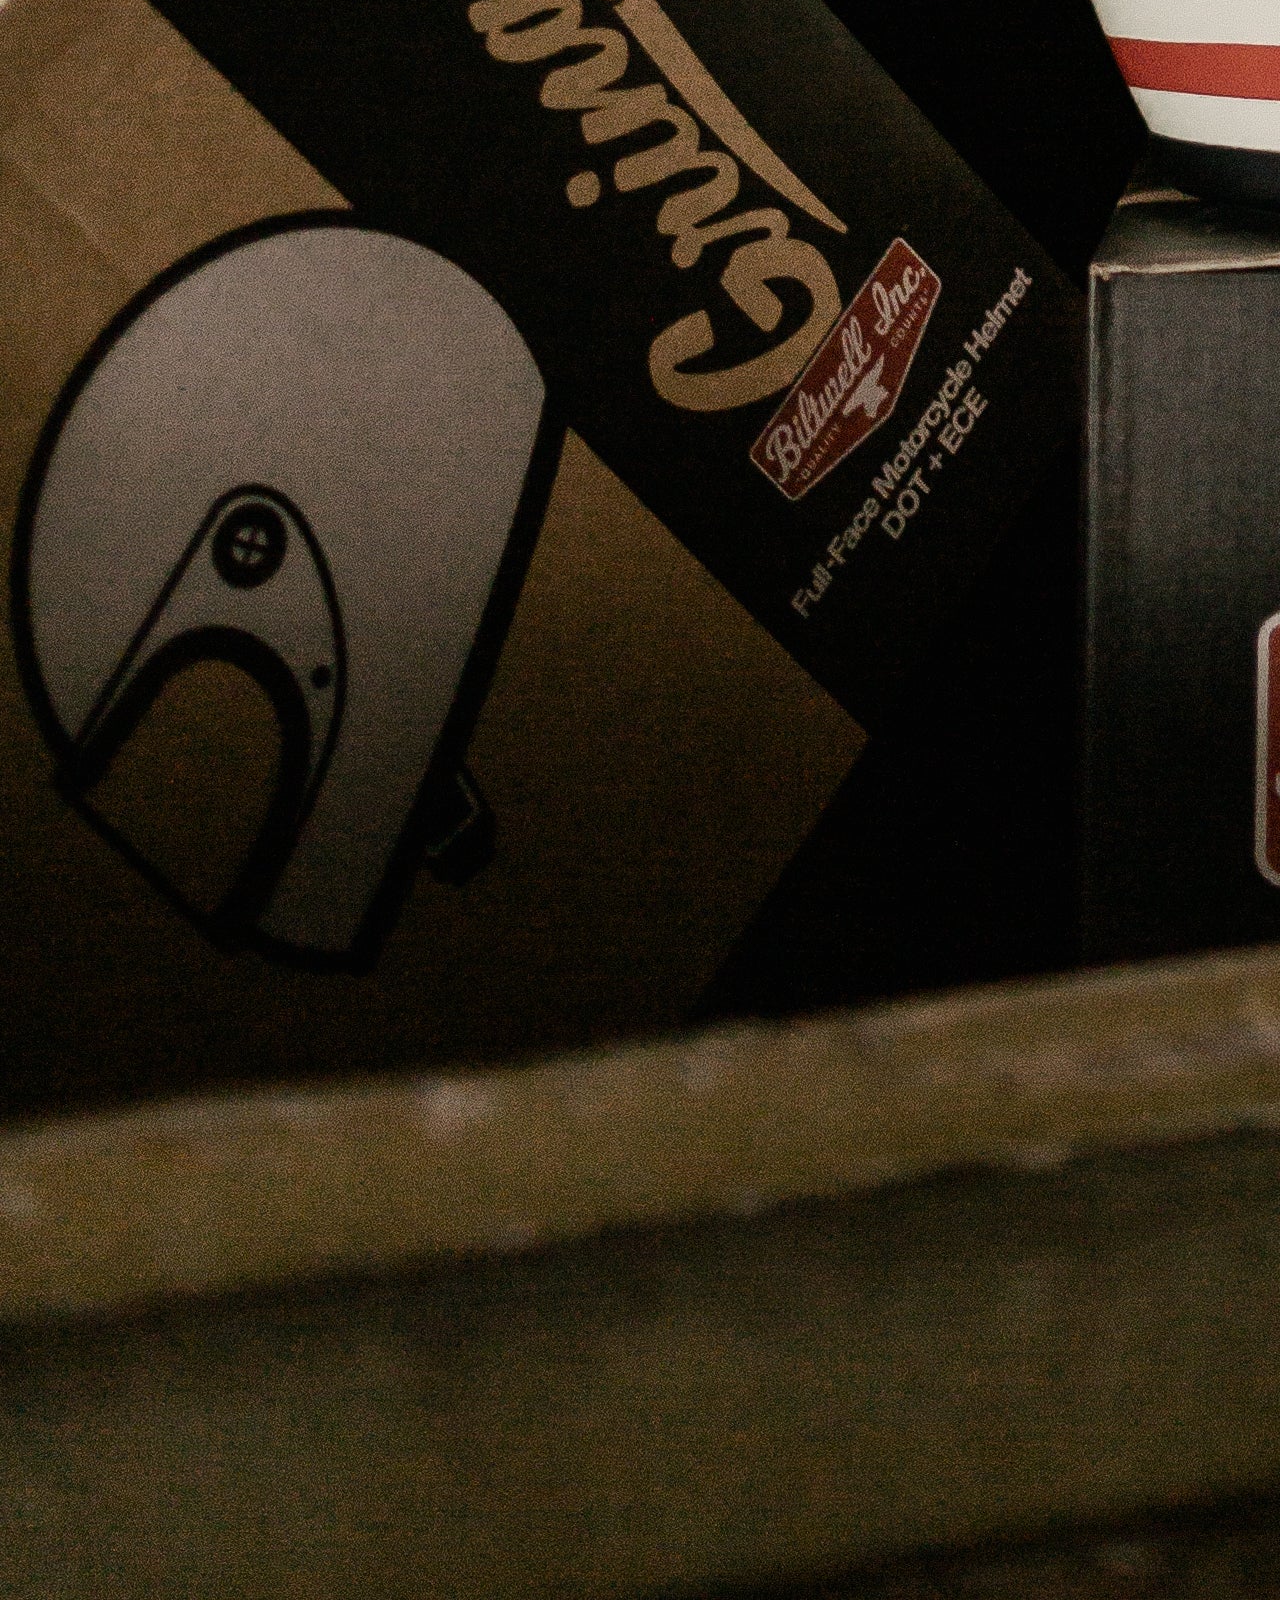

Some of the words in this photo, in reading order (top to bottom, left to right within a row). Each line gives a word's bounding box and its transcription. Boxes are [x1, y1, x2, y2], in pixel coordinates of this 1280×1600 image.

[765, 314, 873, 484] Biltwell
[790, 496, 880, 619] Full-Face
[871, 361, 974, 499] Motorcycle
[963, 265, 1033, 363] Helmet
[880, 466, 934, 542] DOT
[938, 386, 990, 455] ECE
